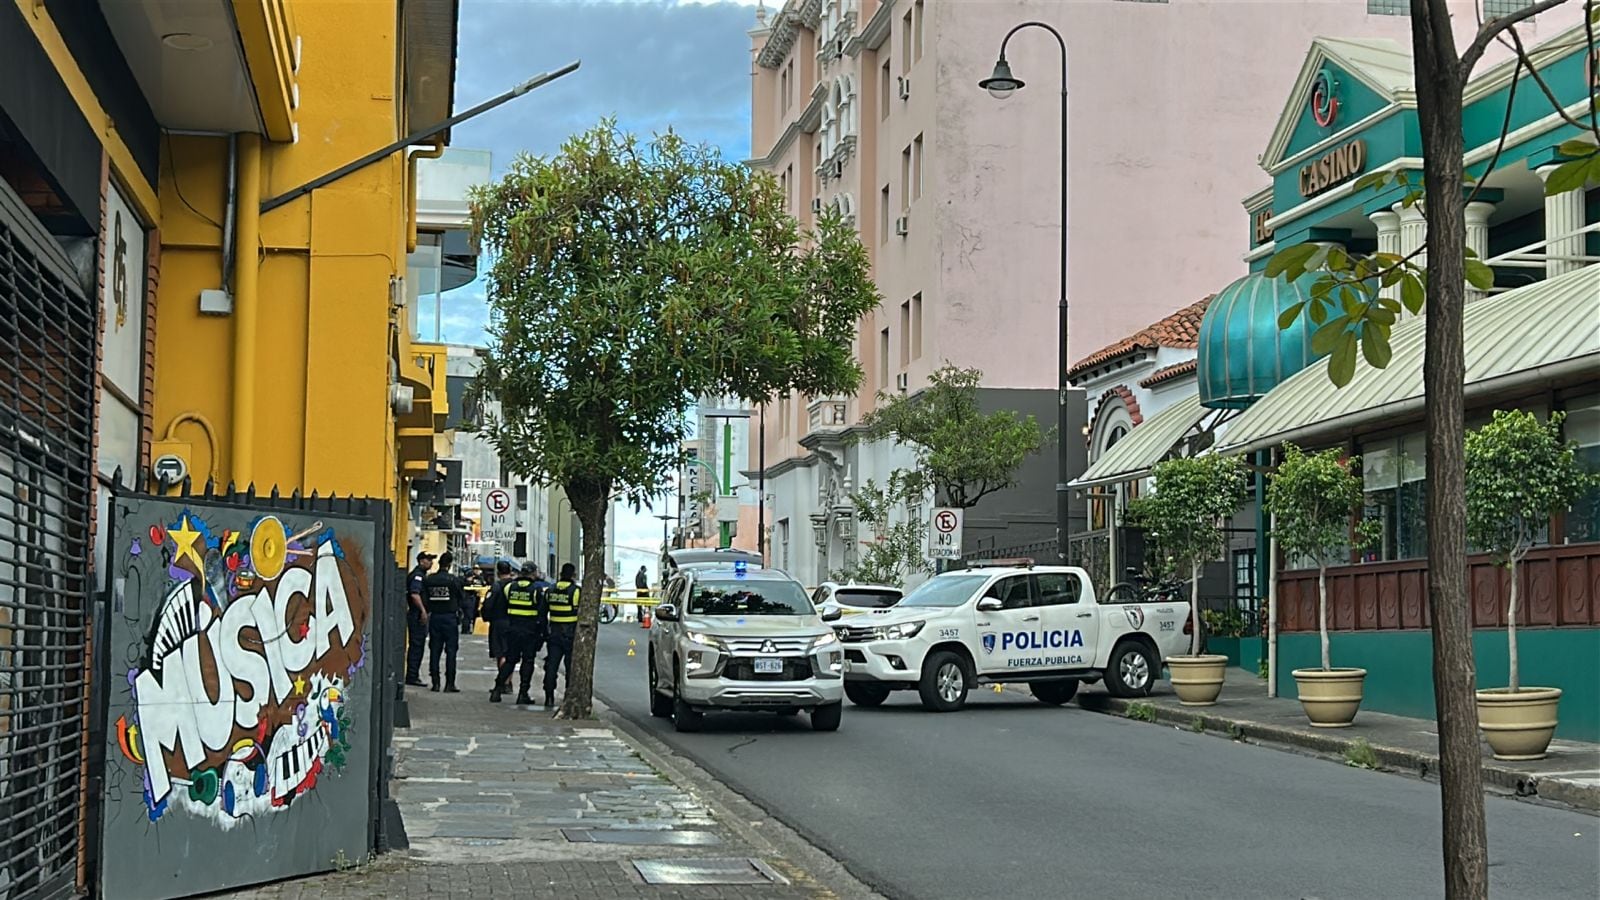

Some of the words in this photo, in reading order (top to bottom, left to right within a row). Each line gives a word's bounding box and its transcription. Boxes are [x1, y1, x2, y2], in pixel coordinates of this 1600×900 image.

[1299, 139, 1366, 197] CASINO
[938, 533, 952, 546] NO
[939, 628, 959, 637] 3457
[1002, 629, 1084, 651] POLICIA
[1008, 657, 1043, 667] FUERZA
[1045, 655, 1082, 665] PUBLICA
